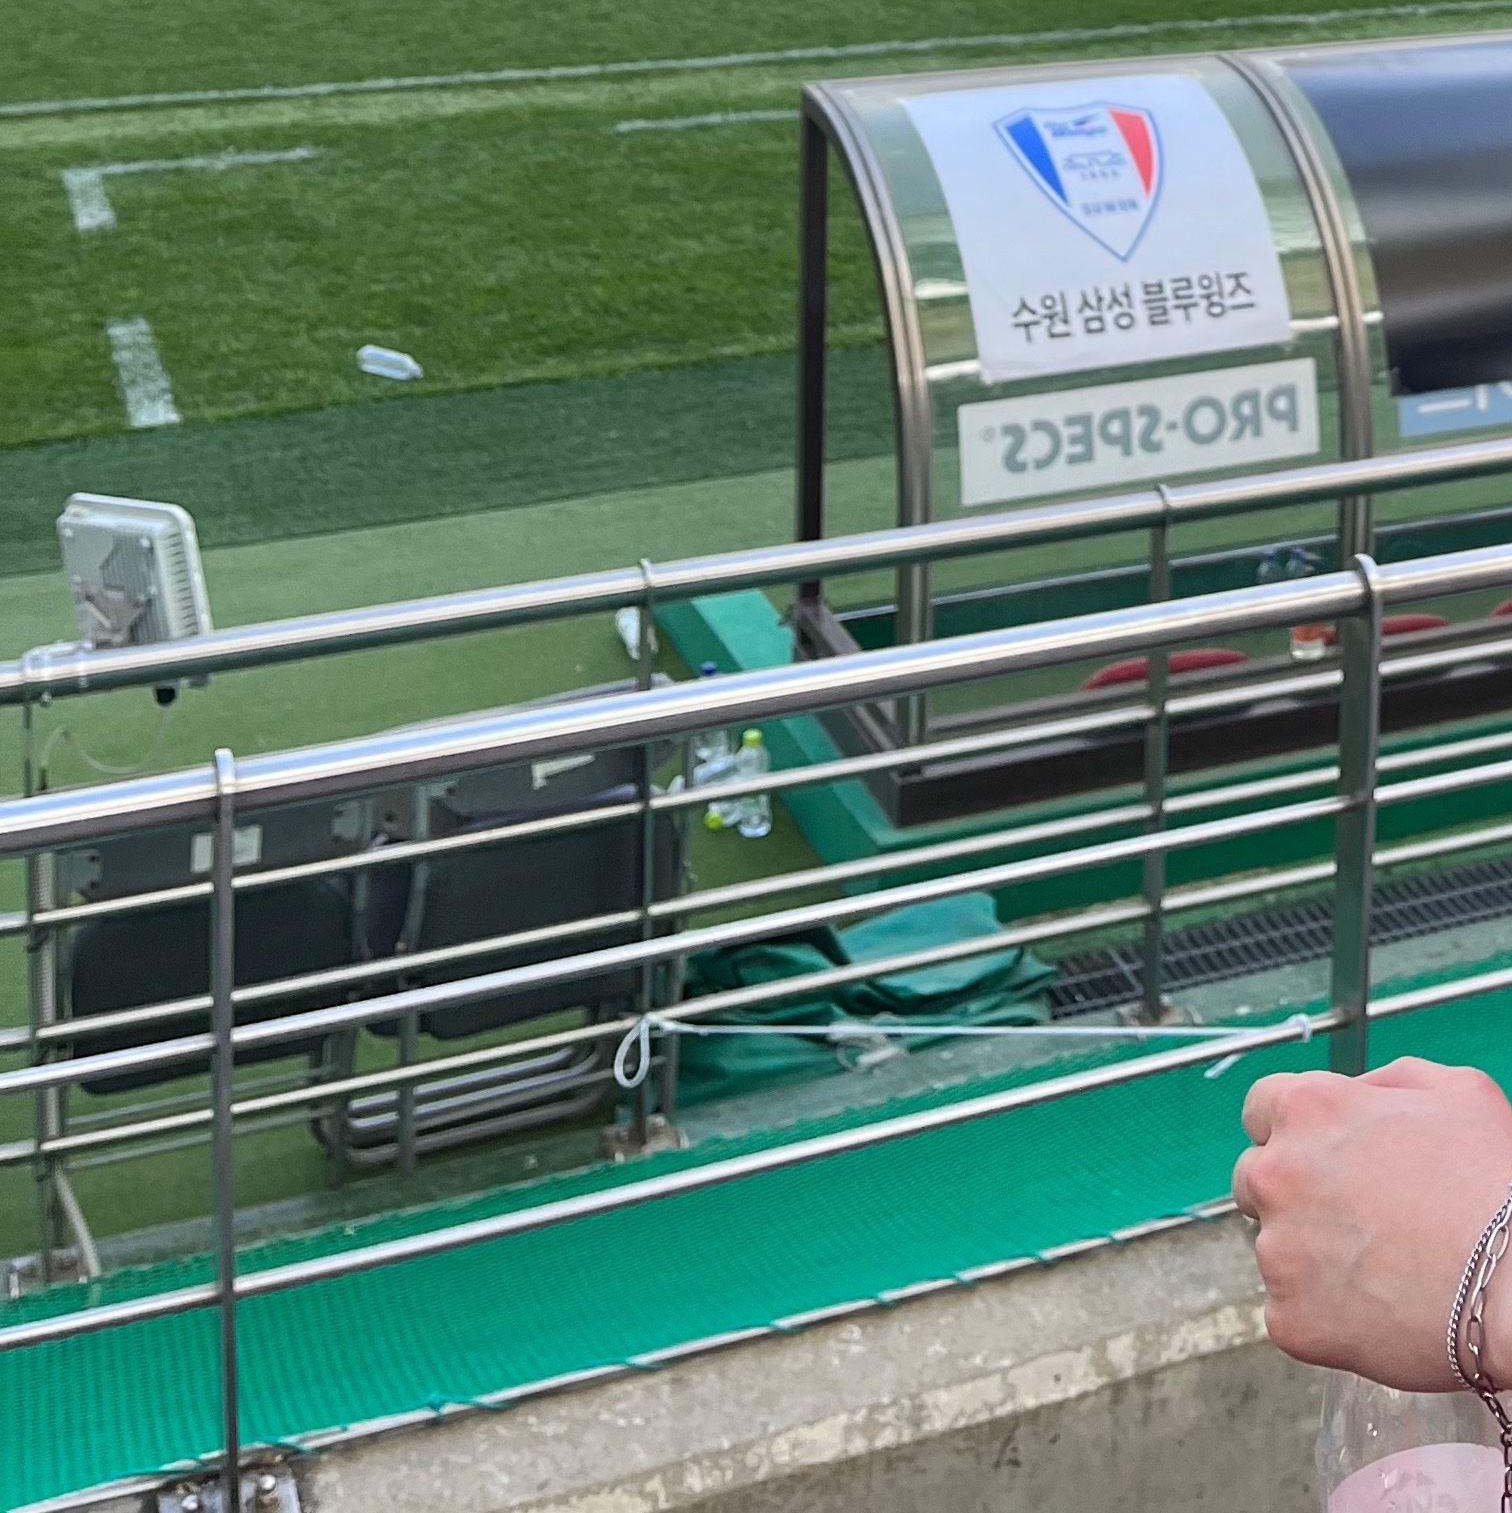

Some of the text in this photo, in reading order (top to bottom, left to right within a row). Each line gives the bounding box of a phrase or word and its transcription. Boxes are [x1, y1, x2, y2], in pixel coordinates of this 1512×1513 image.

[1012, 270, 1256, 344] 수원 삼성 블루윙즈
